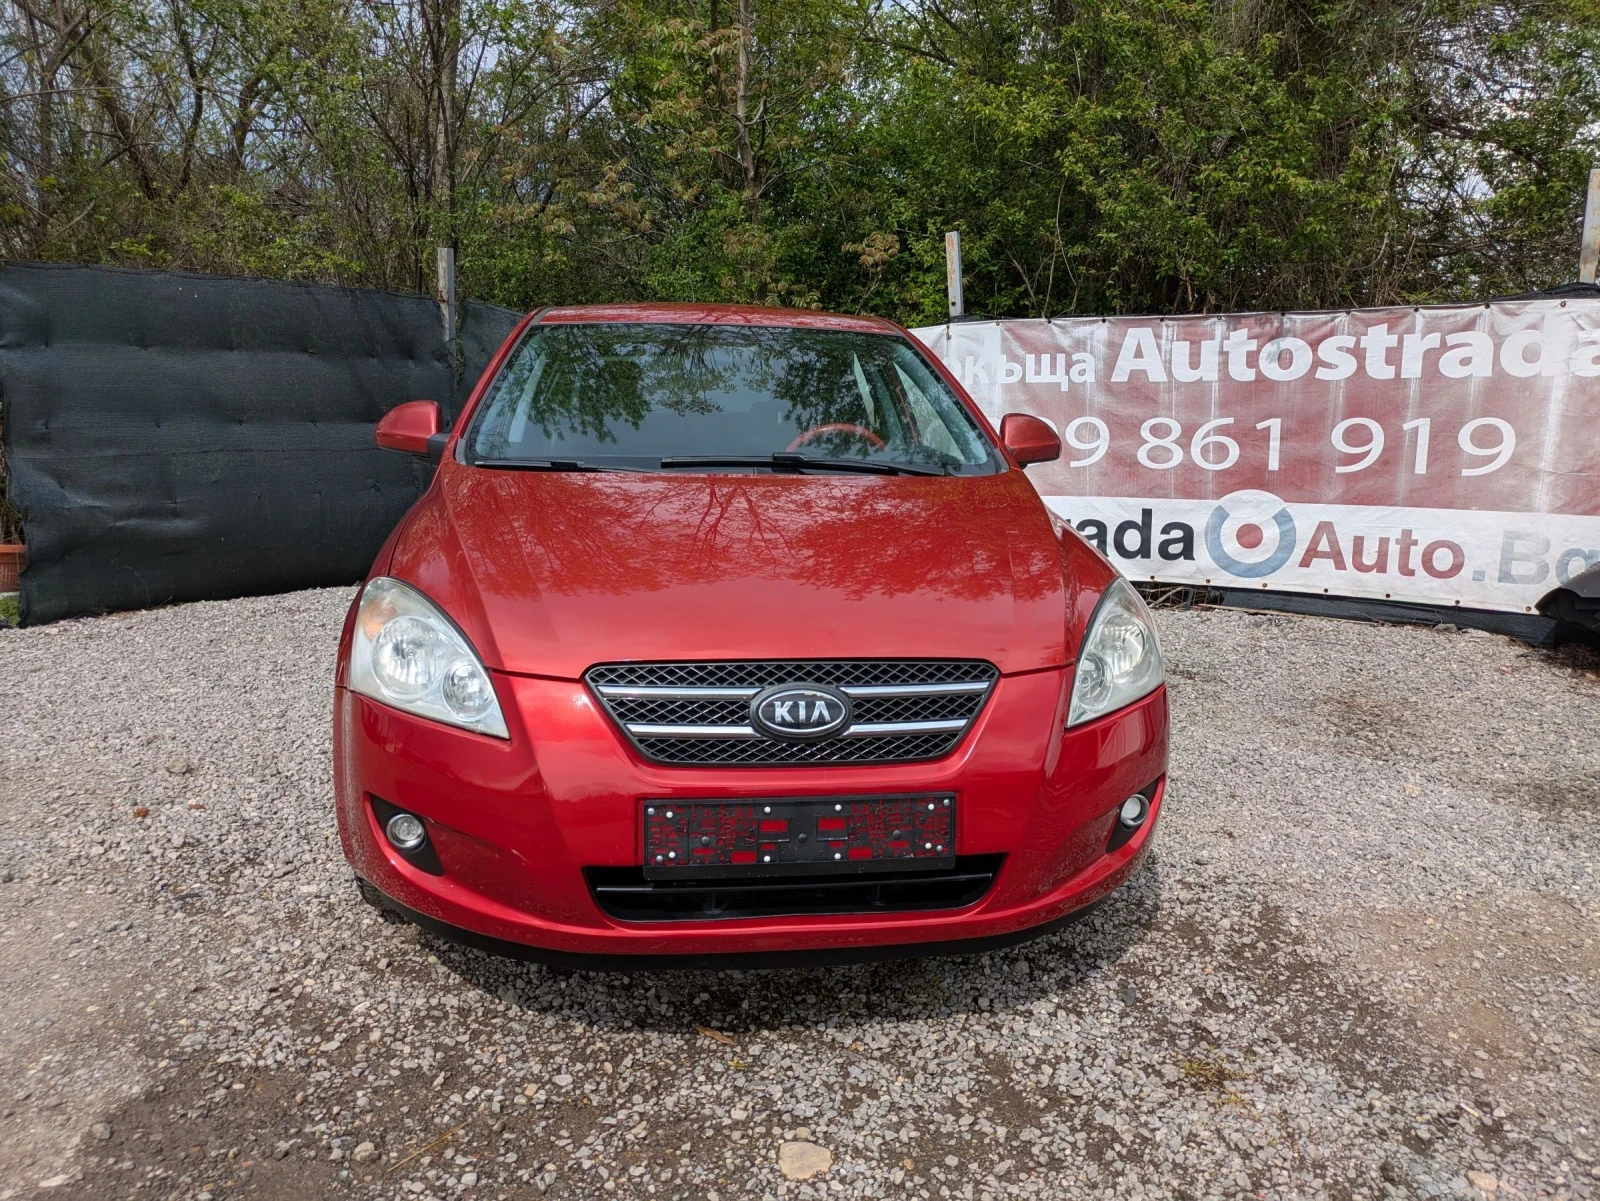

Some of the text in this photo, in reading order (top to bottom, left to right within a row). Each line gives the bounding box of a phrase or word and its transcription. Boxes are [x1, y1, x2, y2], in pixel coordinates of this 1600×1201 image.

[1028, 416, 1516, 477] 9 861 919
[1066, 508, 1196, 561] ada
[773, 700, 832, 723] KIA
